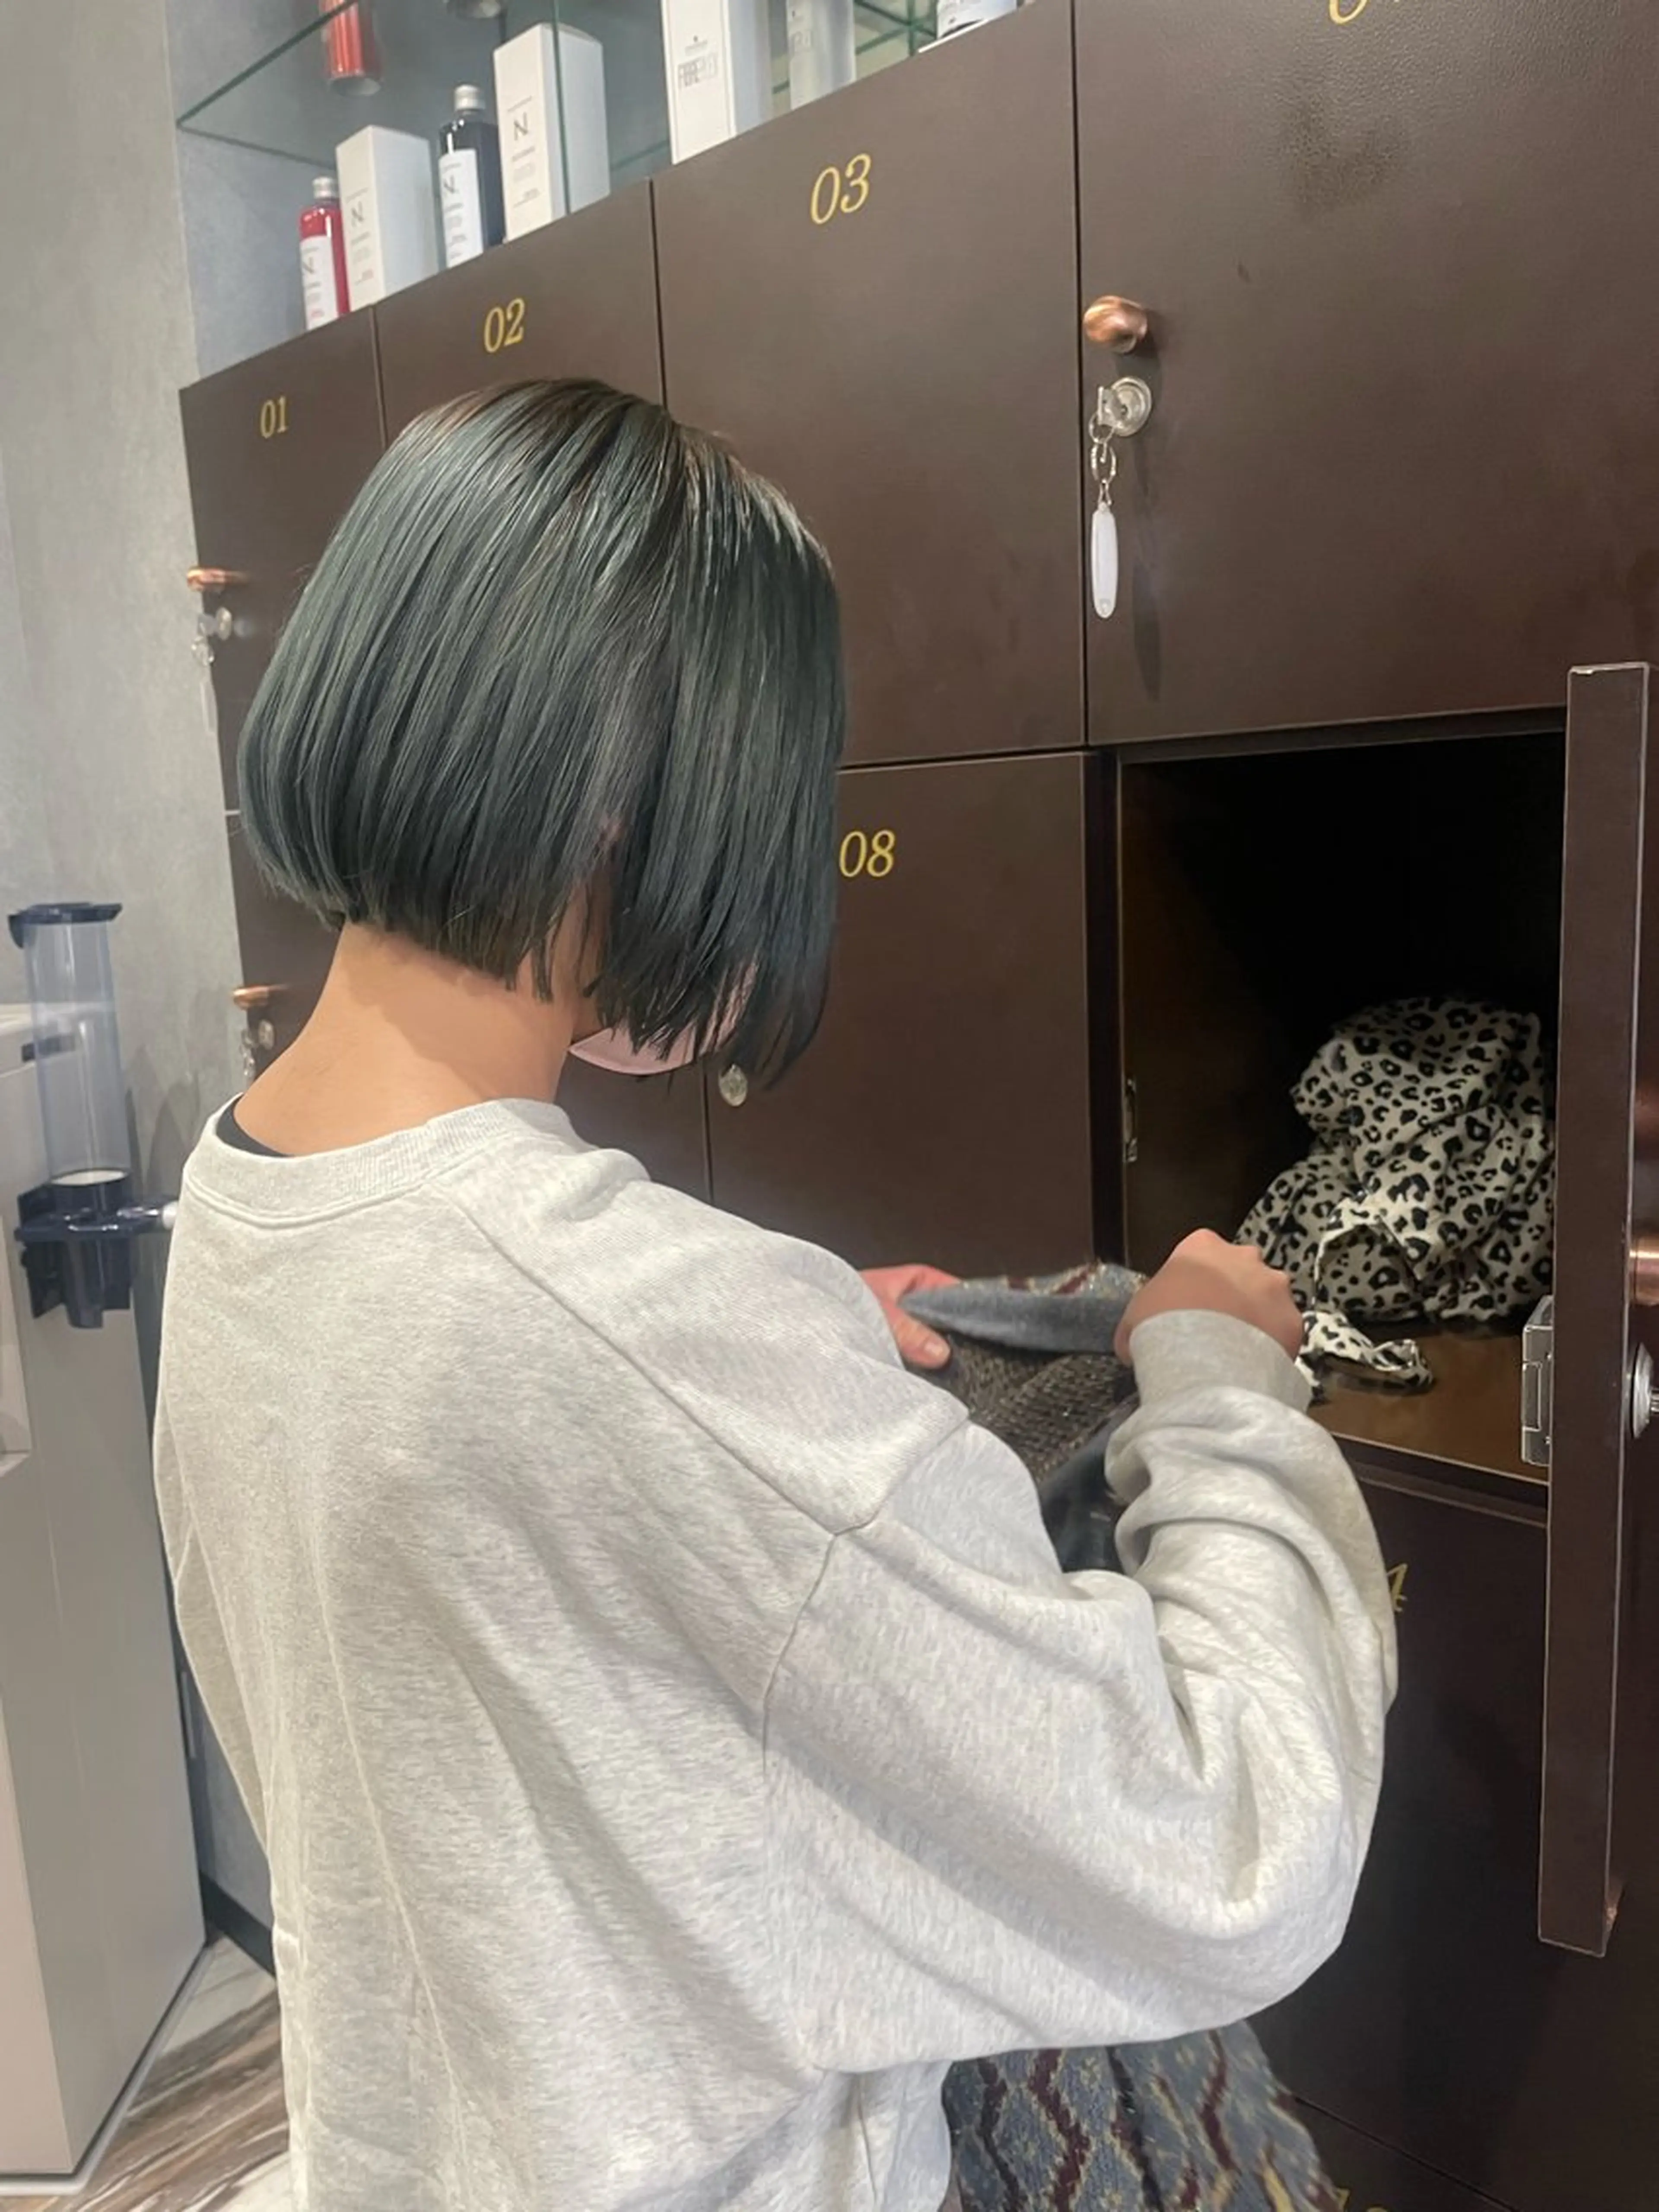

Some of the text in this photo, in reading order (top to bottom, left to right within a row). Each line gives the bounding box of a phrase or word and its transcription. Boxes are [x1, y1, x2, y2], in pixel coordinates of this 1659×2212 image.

[811, 154, 871, 224] 03
[484, 298, 524, 353] 02
[261, 396, 288, 439] 01
[839, 830, 895, 877] 08
